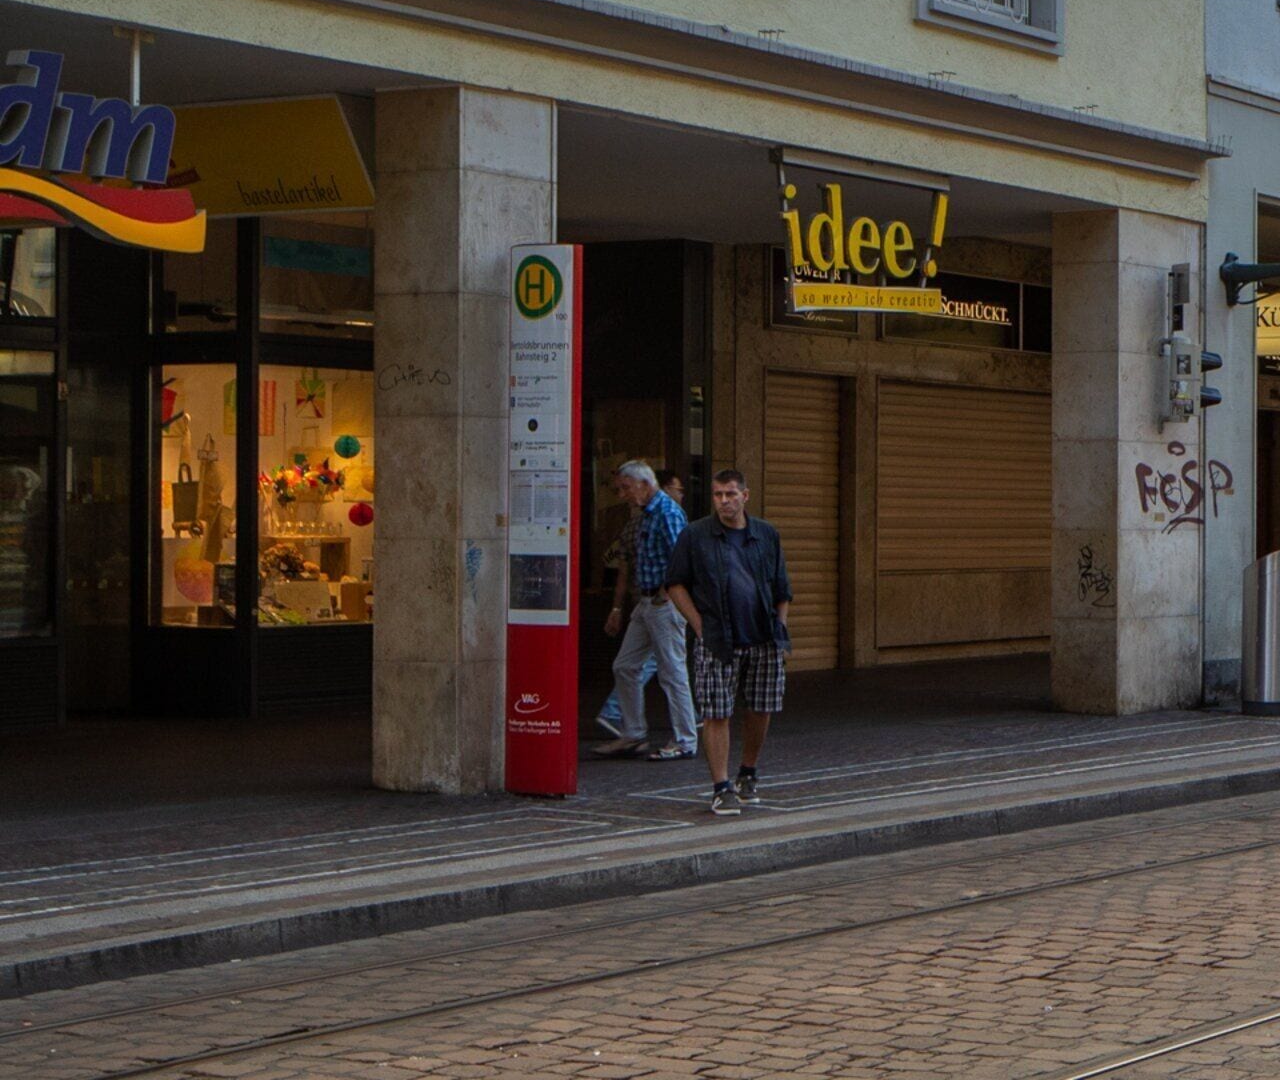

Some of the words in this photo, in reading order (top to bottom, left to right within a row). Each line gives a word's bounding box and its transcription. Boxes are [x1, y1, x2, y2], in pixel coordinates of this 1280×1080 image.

[0, 49, 176, 184] dm
[236, 174, 342, 207] bastelartikel
[782, 183, 948, 278] idee!
[801, 293, 815, 305] so
[865, 289, 883, 306] ich
[889, 294, 936, 309] creativ
